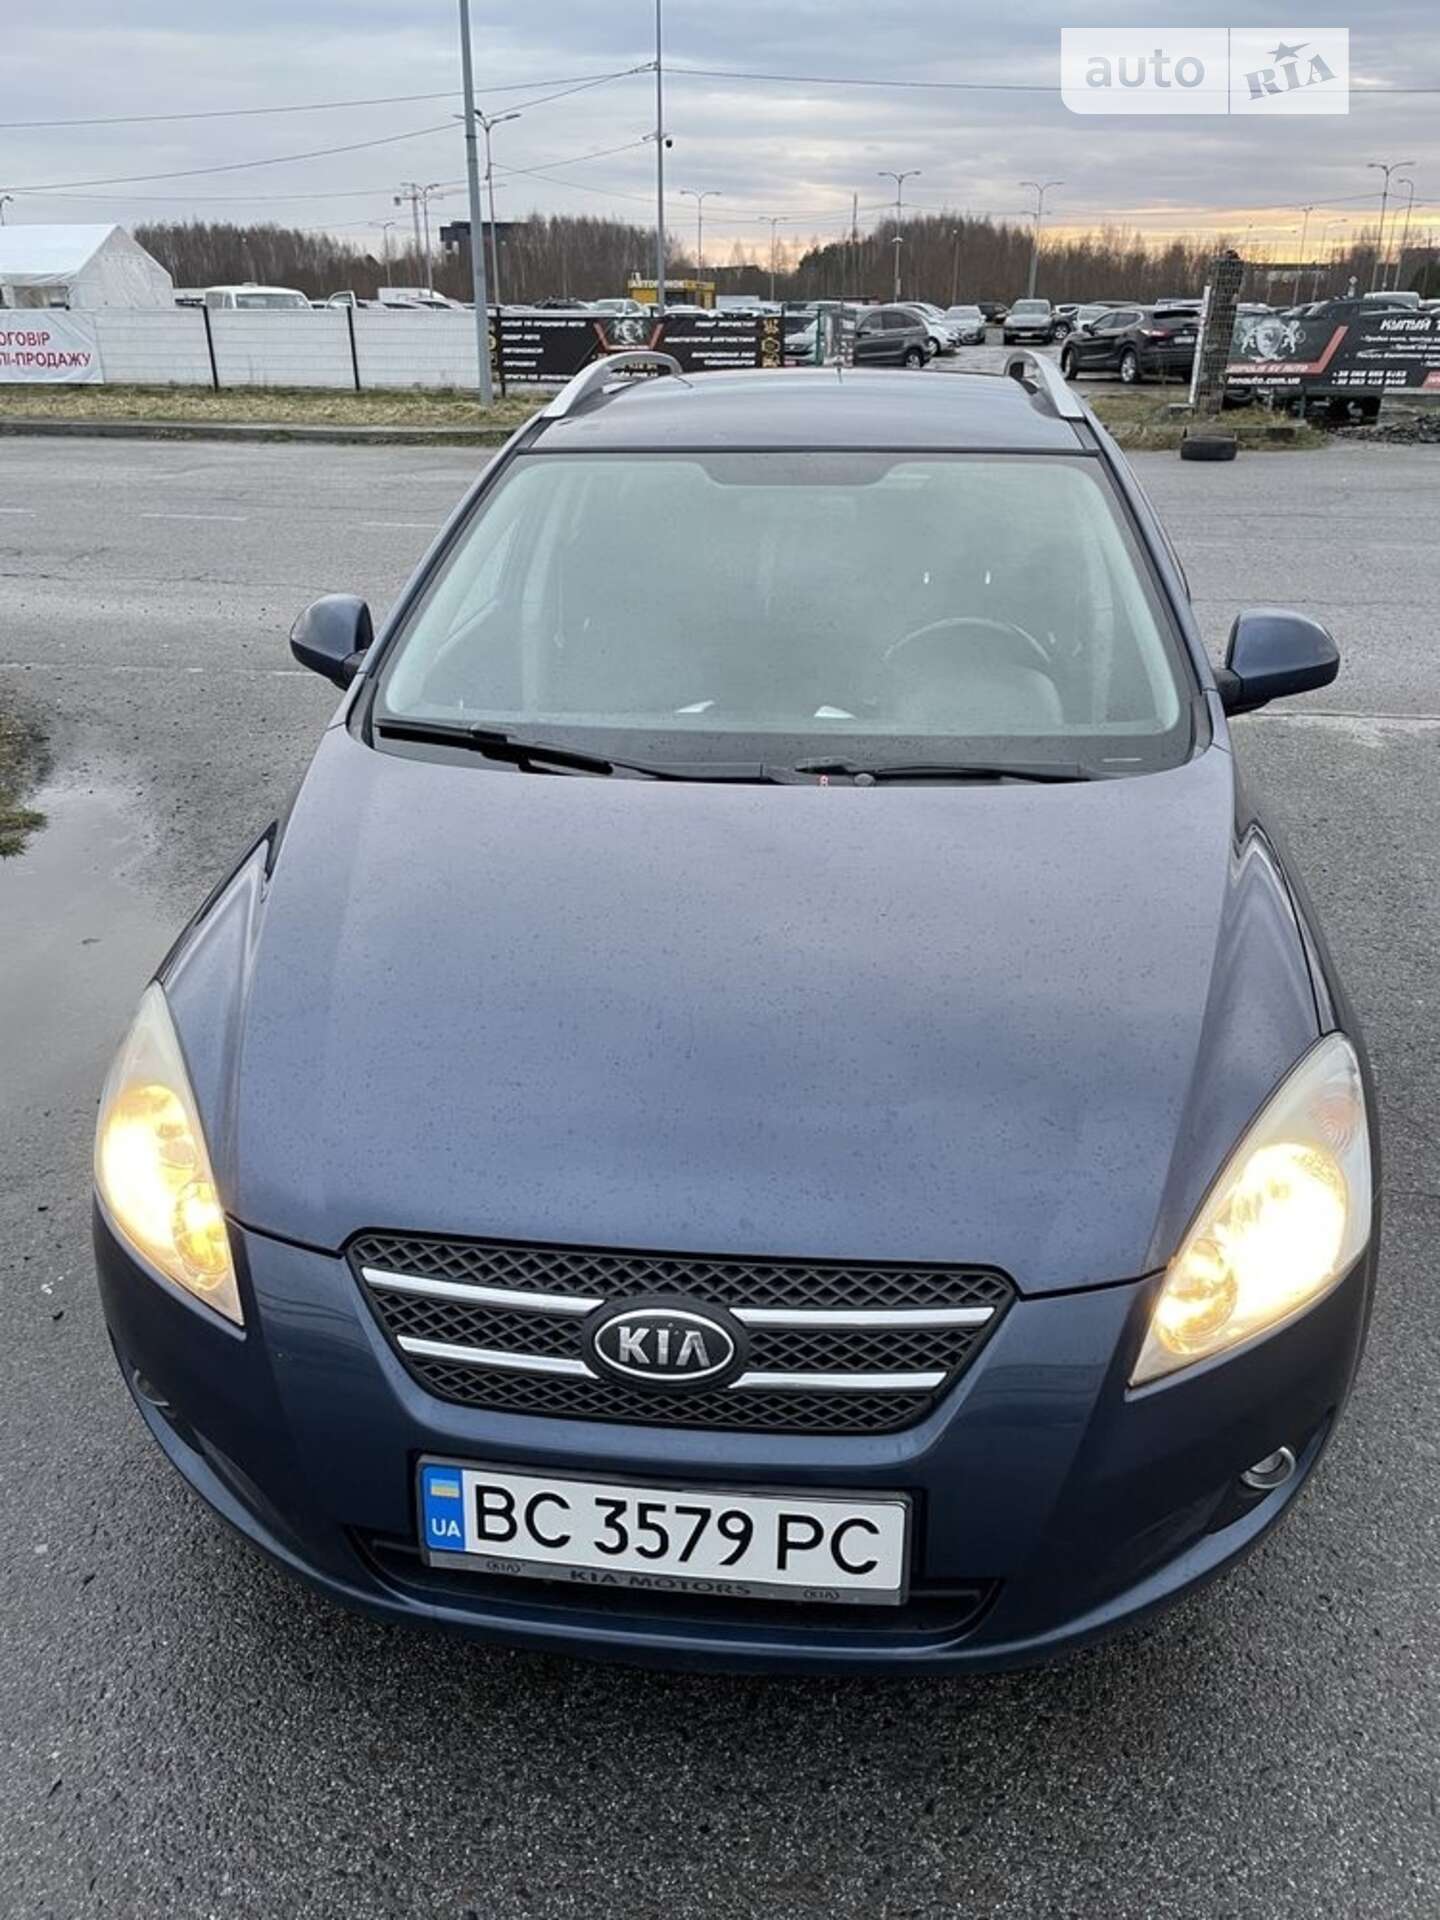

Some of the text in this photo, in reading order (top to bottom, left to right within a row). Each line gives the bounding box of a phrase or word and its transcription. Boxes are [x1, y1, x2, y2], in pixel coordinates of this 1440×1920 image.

[618, 1326, 711, 1367] KIA
[432, 1517, 462, 1539] UA
[475, 1484, 880, 1576] BC 3579 PC
[570, 1570, 751, 1596] KIA MOTORS
